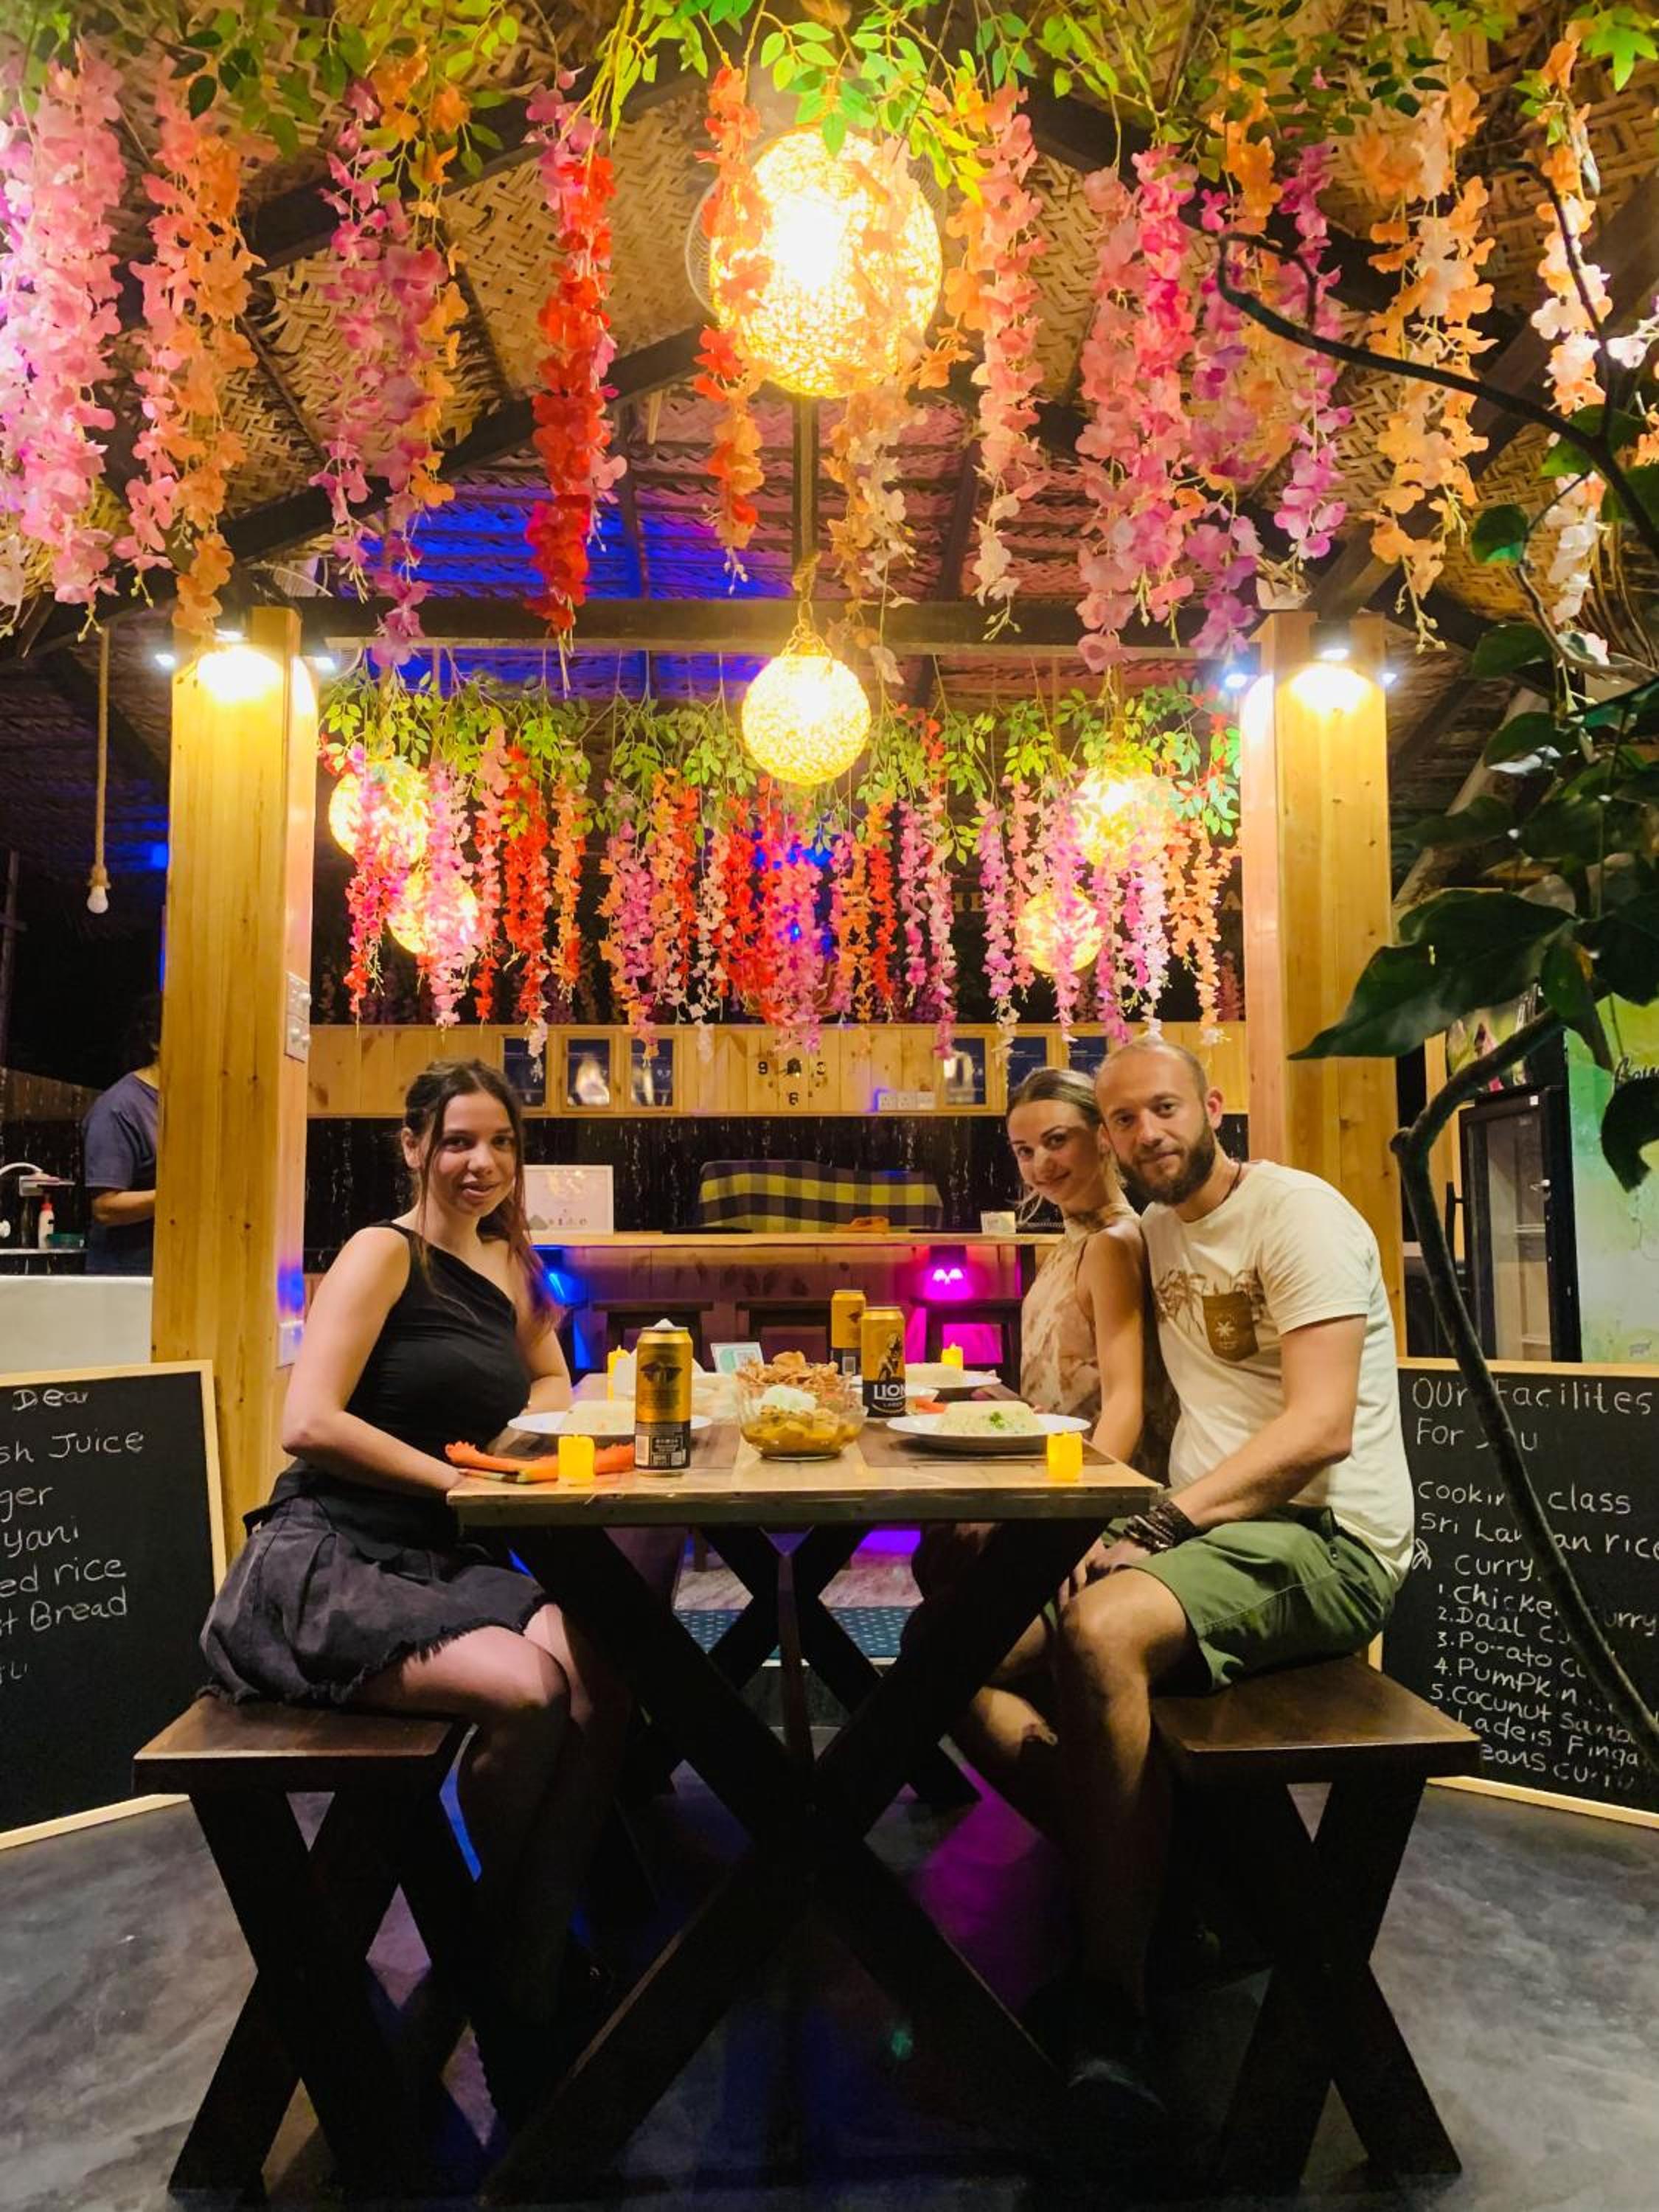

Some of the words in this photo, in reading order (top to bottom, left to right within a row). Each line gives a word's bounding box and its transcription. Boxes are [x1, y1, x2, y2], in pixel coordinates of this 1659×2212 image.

[11, 1388, 89, 1411] Dear
[48, 1428, 144, 1458] Juice
[1416, 1417, 1464, 1445] For
[1420, 1512, 1459, 1534] Sri
[54, 1557, 127, 1585] rice
[30, 1586, 128, 1632] Bread
[1603, 1612, 1657, 1637] urry
[1481, 1744, 1547, 1773] eans
